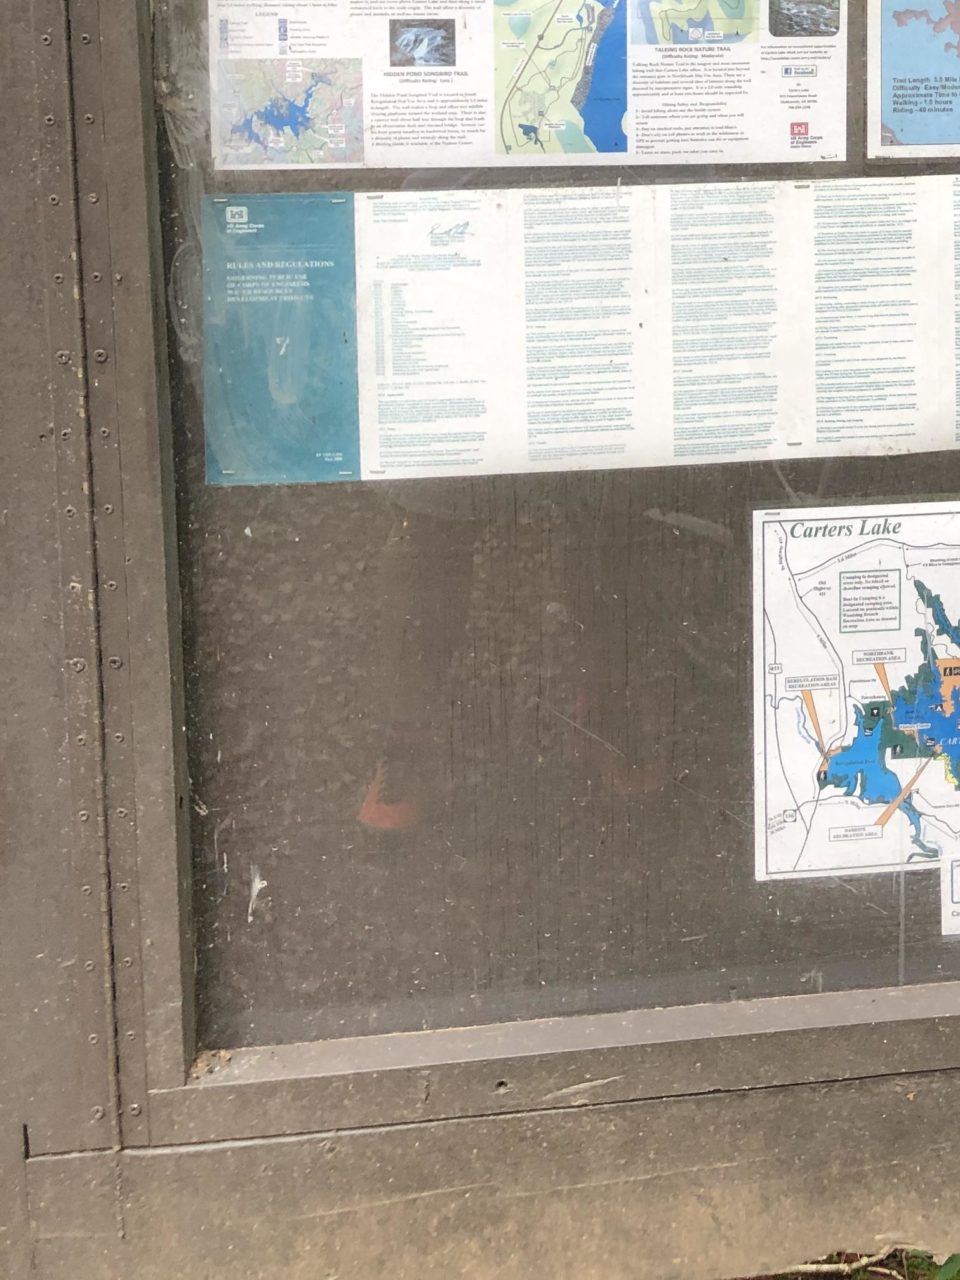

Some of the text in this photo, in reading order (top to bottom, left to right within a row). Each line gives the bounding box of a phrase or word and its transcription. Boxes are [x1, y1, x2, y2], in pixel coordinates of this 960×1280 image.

[256, 261, 272, 269] AND
[275, 260, 334, 268] REGULATIONS
[790, 519, 901, 539] Carters Lake
